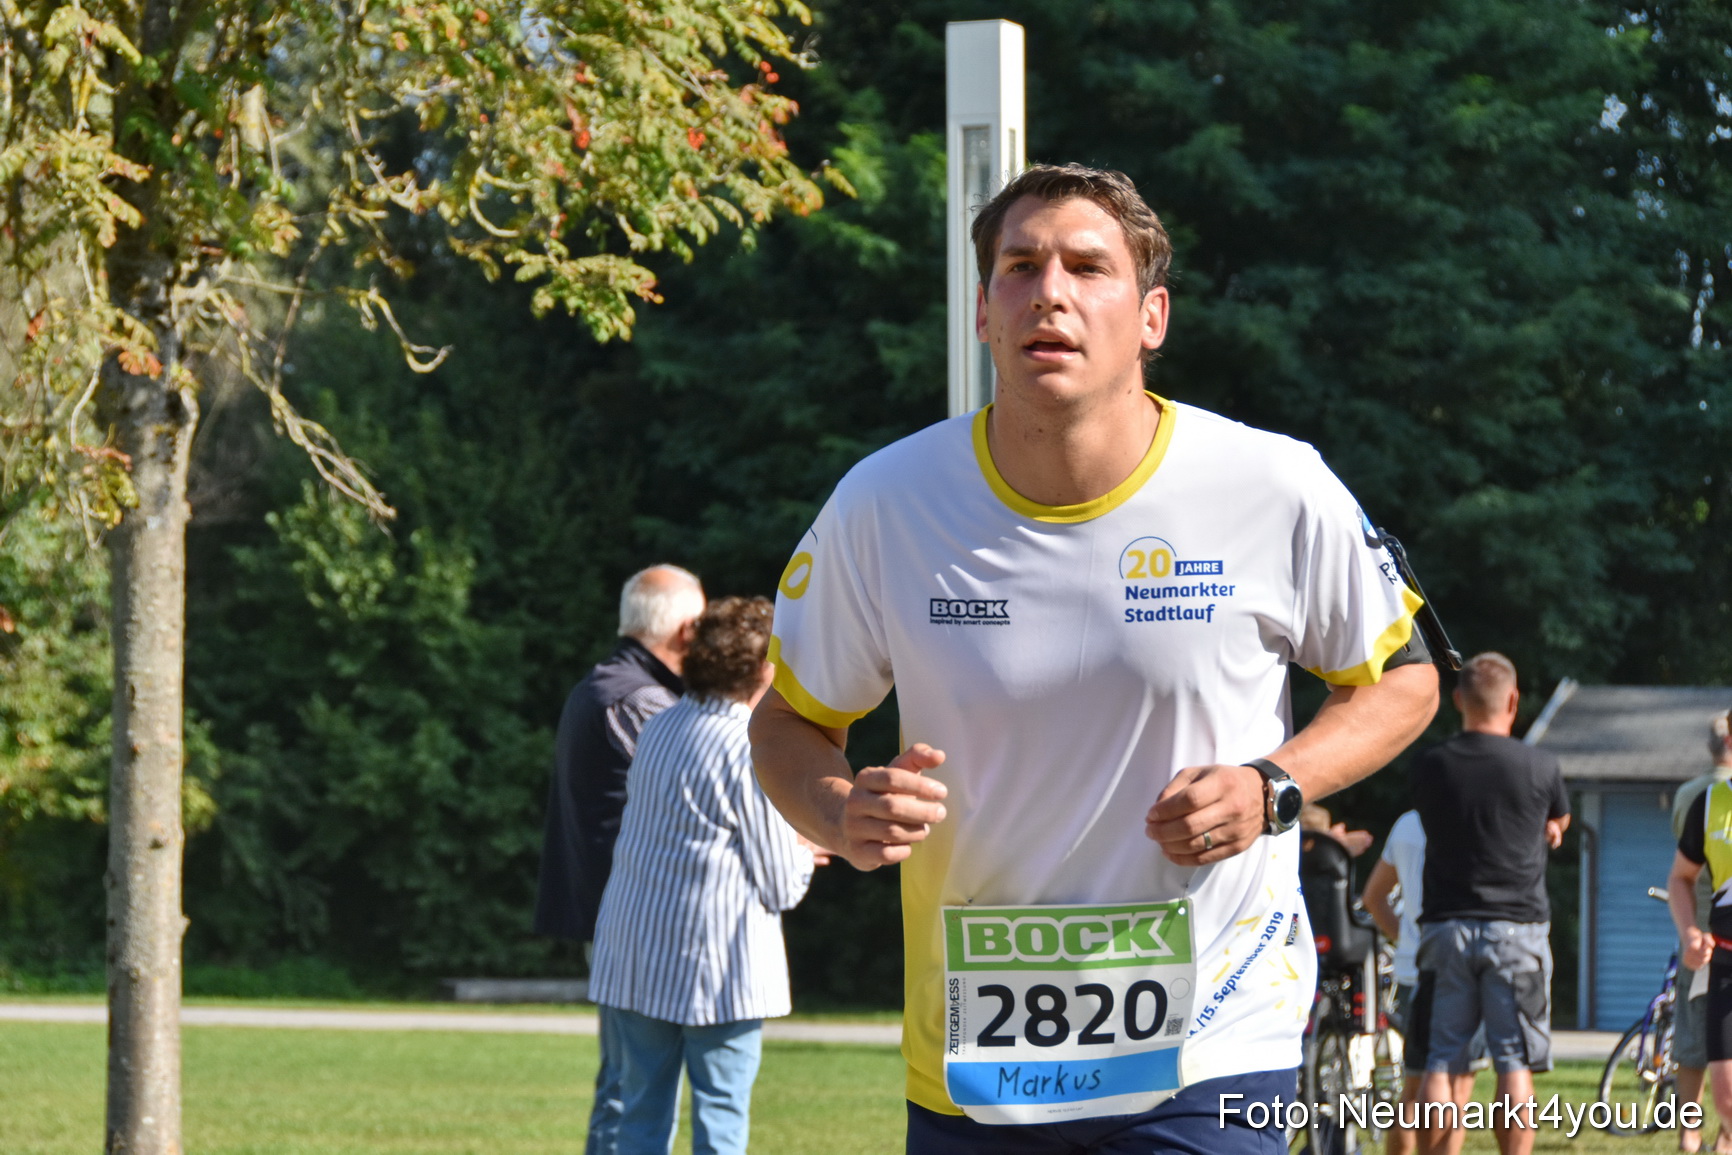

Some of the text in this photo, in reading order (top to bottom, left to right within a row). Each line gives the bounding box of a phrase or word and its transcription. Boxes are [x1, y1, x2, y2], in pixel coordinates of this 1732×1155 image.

[1126, 548, 1219, 579] 20 JAHRE
[1125, 582, 1236, 600] Neumarkter
[930, 598, 1010, 619] BOCK
[1124, 604, 1216, 623] Stadtlauf
[962, 910, 1174, 963] BOCK
[1213, 942, 1267, 1004] September
[1261, 911, 1285, 941] 2019
[977, 980, 1168, 1047] 2820
[998, 1064, 1101, 1099] Markus
